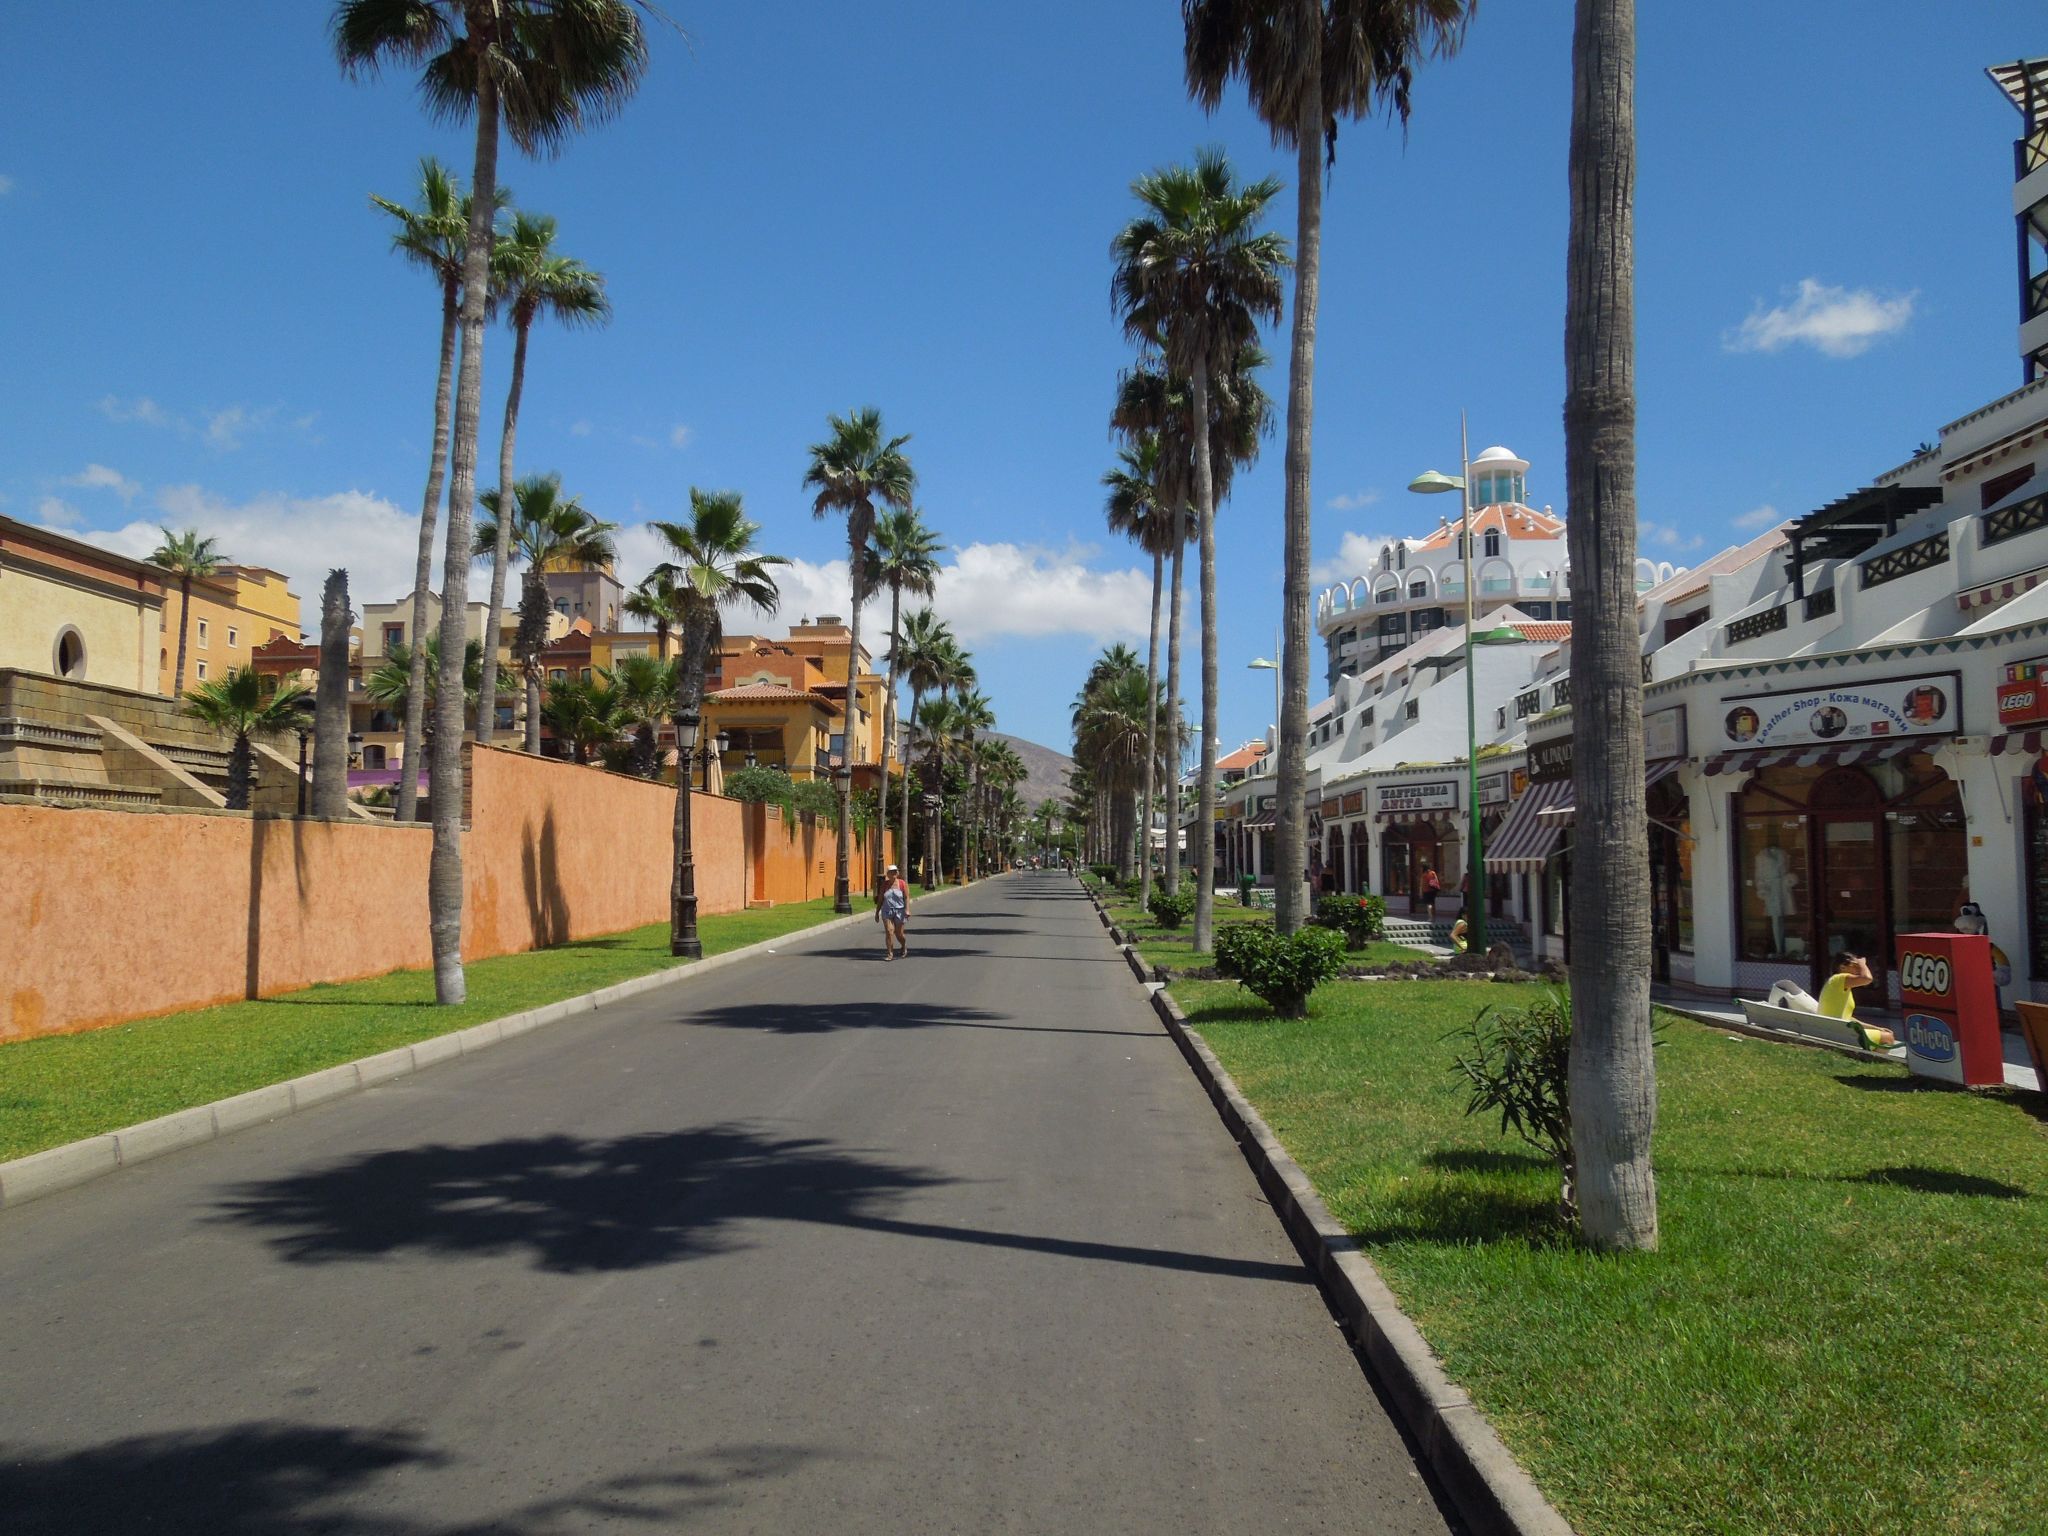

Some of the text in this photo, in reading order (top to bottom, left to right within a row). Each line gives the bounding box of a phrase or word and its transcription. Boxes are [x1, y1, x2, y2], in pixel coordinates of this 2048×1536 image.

[1757, 707, 1792, 744] Leather
[1793, 696, 1820, 712] Shop
[1829, 692, 1859, 704] Кожа
[1861, 698, 1909, 732] магазин
[2000, 692, 2033, 711] LEGO
[1381, 797, 1423, 809] ANITA
[1902, 954, 1949, 994] LEGO
[1909, 1019, 1951, 1052] chicco
